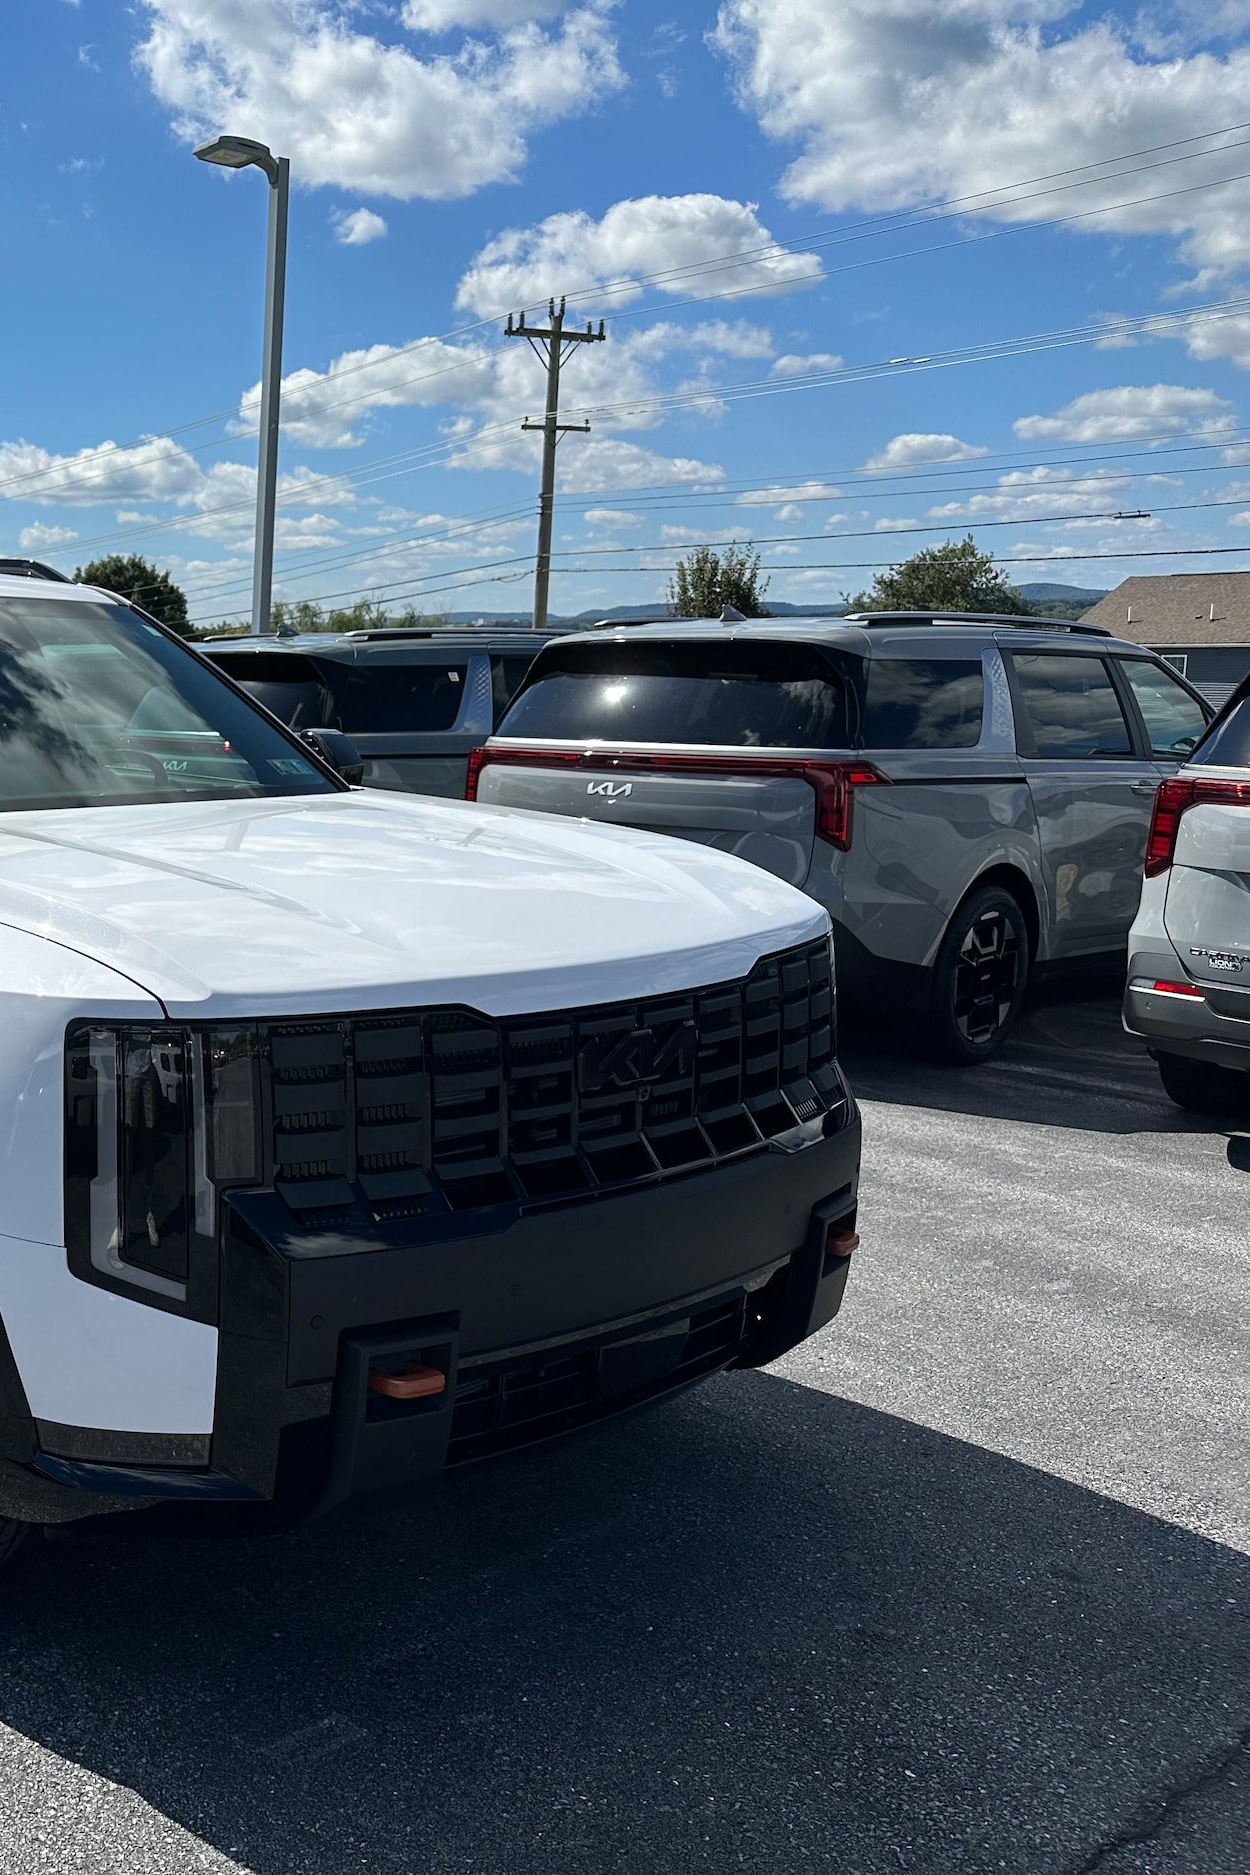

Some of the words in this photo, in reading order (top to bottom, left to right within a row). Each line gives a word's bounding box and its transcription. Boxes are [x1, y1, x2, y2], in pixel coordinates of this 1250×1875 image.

[163, 760, 188, 771] KIA
[587, 781, 632, 797] KIA
[1209, 958, 1233, 968] LION
[577, 1019, 699, 1093] KIA
